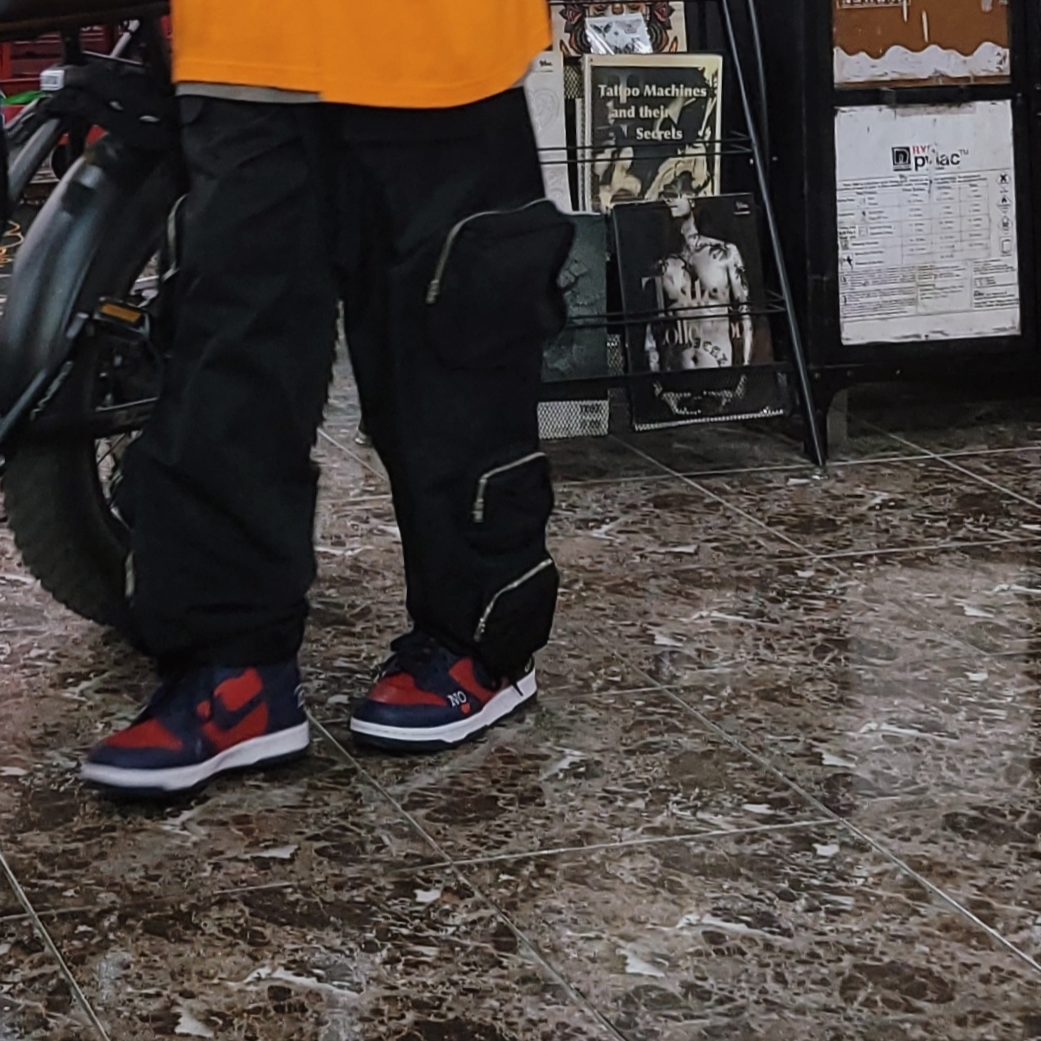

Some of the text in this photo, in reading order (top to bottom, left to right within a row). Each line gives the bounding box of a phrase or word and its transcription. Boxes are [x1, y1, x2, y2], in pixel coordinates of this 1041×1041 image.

[644, 84, 707, 97] Machines
[611, 105, 636, 118] and
[636, 127, 683, 140] Secrets
[447, 690, 467, 708] NO
